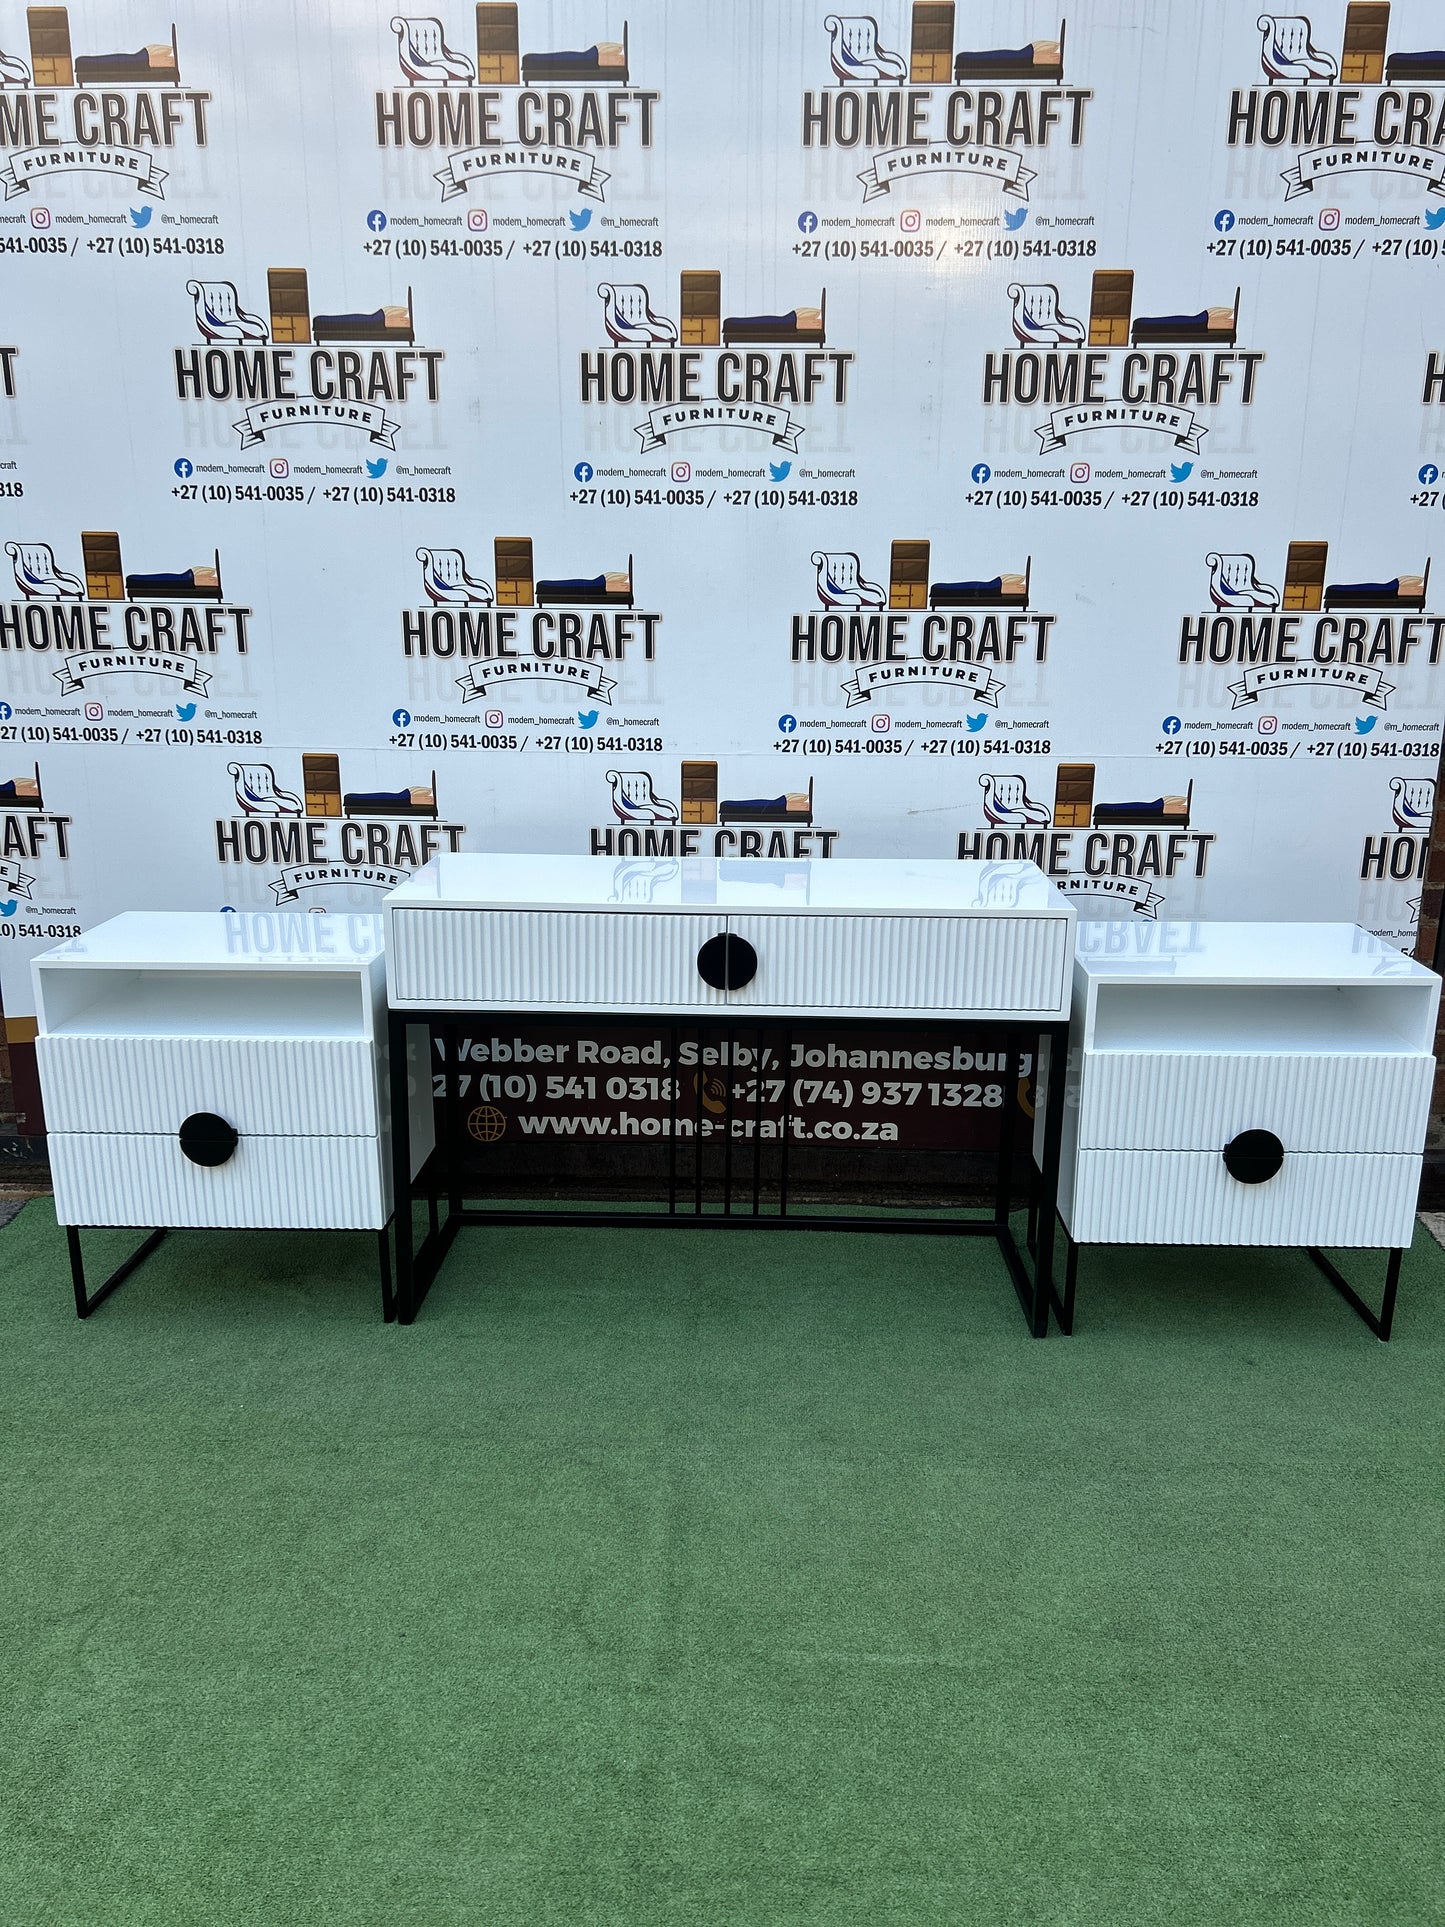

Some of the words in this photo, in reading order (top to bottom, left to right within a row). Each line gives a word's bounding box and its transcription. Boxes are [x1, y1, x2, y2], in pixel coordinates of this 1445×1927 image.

[73, 92, 212, 145] CRAFT
[376, 92, 502, 146] HOME
[518, 92, 657, 146] CRAFT
[802, 91, 931, 146] HOME
[947, 90, 1089, 145] CRAFT
[1227, 90, 1360, 144] HOME
[23, 151, 138, 171] FURNITURE
[463, 152, 581, 171] FURNITURE
[888, 151, 1009, 172] FURNITURE
[1312, 150, 1433, 170] FURNITURE
[161, 214, 219, 225] @m_homecraft
[601, 217, 659, 227] @m_homecraft
[1036, 216, 1094, 227] @m_homecraft
[86, 238, 114, 253] +27
[118, 237, 150, 257] (10)
[152, 237, 225, 254] 541-0318
[363, 240, 391, 256] +27
[395, 240, 426, 259] (10)
[523, 241, 551, 256] +27
[555, 240, 586, 260] (10)
[590, 240, 662, 257] 541-0318
[792, 241, 820, 257] +27
[824, 241, 856, 260] (10)
[954, 241, 982, 257] +27
[987, 240, 1019, 260] (10)
[1022, 240, 1096, 257] 541-0318
[1206, 240, 1236, 256] +27
[1239, 239, 1272, 259] (10)
[1371, 240, 1401, 256] +27
[1404, 240, 1438, 259] (10)
[174, 349, 297, 399] HOME
[309, 350, 444, 400] CRAFT
[580, 352, 702, 402] HOME
[717, 352, 851, 402] CRAFT
[982, 353, 1108, 403] HOME
[1121, 353, 1261, 403] CRAFT
[261, 405, 372, 424] FURNITURE
[663, 408, 777, 426] FURNITURE
[1063, 409, 1180, 427] FURNITURE
[395, 465, 451, 475] @m_homecraft
[798, 468, 854, 478] @m_homecraft
[1199, 469, 1257, 479] @m_homecraft
[171, 485, 198, 500] +27
[201, 485, 232, 503] (10)
[323, 487, 350, 501] +27
[353, 487, 384, 505] (10)
[386, 487, 456, 503] 541-0318
[570, 490, 596, 504] +27
[600, 489, 630, 507] (10)
[723, 491, 750, 505] +27
[754, 490, 785, 508] (10)
[788, 490, 858, 506] 541-0318
[965, 491, 993, 505] +27
[996, 491, 1027, 509] (10)
[1121, 492, 1149, 506] +27
[1152, 491, 1184, 509] (10)
[1187, 491, 1259, 507] 541-0318
[1410, 492, 1439, 506] +27
[0, 604, 112, 650] HOME
[125, 606, 252, 652] CRAFT
[402, 610, 518, 657] HOME
[532, 612, 660, 659] CRAFT
[790, 616, 909, 661] HOME
[921, 615, 1054, 661] CRAFT
[1177, 617, 1301, 662] HOME
[1312, 617, 1445, 663] CRAFT
[78, 655, 184, 672] FURNITURE
[482, 662, 589, 679] FURNITURE
[870, 666, 979, 682] FURNITURE
[1258, 667, 1370, 684] FURNITURE
[204, 710, 257, 719] @m_homecraft
[606, 717, 659, 727] @m_homecraft
[994, 720, 1049, 729] @m_homecraft
[1382, 723, 1439, 732] @m_homecraft
[20, 727, 49, 743] (10)
[136, 729, 161, 742] +27
[164, 729, 194, 745] (10)
[196, 729, 262, 744] 541-0318
[388, 734, 414, 748] +27
[418, 734, 447, 751] (10)
[535, 736, 561, 750] +27
[564, 736, 593, 753] (10)
[596, 737, 662, 751] 541-0318
[773, 740, 799, 753] +27
[802, 739, 831, 756] (10)
[920, 740, 947, 753] +27
[950, 740, 980, 756] (10)
[983, 740, 1051, 754] 541-0318
[1155, 741, 1183, 755] +27
[1185, 741, 1216, 758] (10)
[1306, 743, 1334, 756] +27
[1336, 742, 1368, 759] (10)
[1369, 743, 1440, 757] 541-0318
[216, 820, 328, 863] HOME
[341, 823, 465, 866] CRAFT
[958, 833, 1071, 875] HOME
[1084, 834, 1215, 876] CRAFT
[294, 868, 399, 884] FURNITURE
[25, 906, 77, 916] @m_homecraft
[19, 925, 81, 938] 541-0318
[577, 1040, 671, 1068] Road,
[678, 1041, 780, 1073] Selby,
[791, 1044, 1033, 1078] Johannesburg
[480, 1073, 537, 1102] (10)
[546, 1075, 597, 1099] 541
[606, 1076, 681, 1101] 0318
[732, 1079, 786, 1103] +27
[793, 1079, 854, 1108] (74)
[861, 1081, 922, 1106] 937
[927, 1083, 1003, 1108] 1328
[518, 1111, 898, 1141] www.home-craft.co.za
